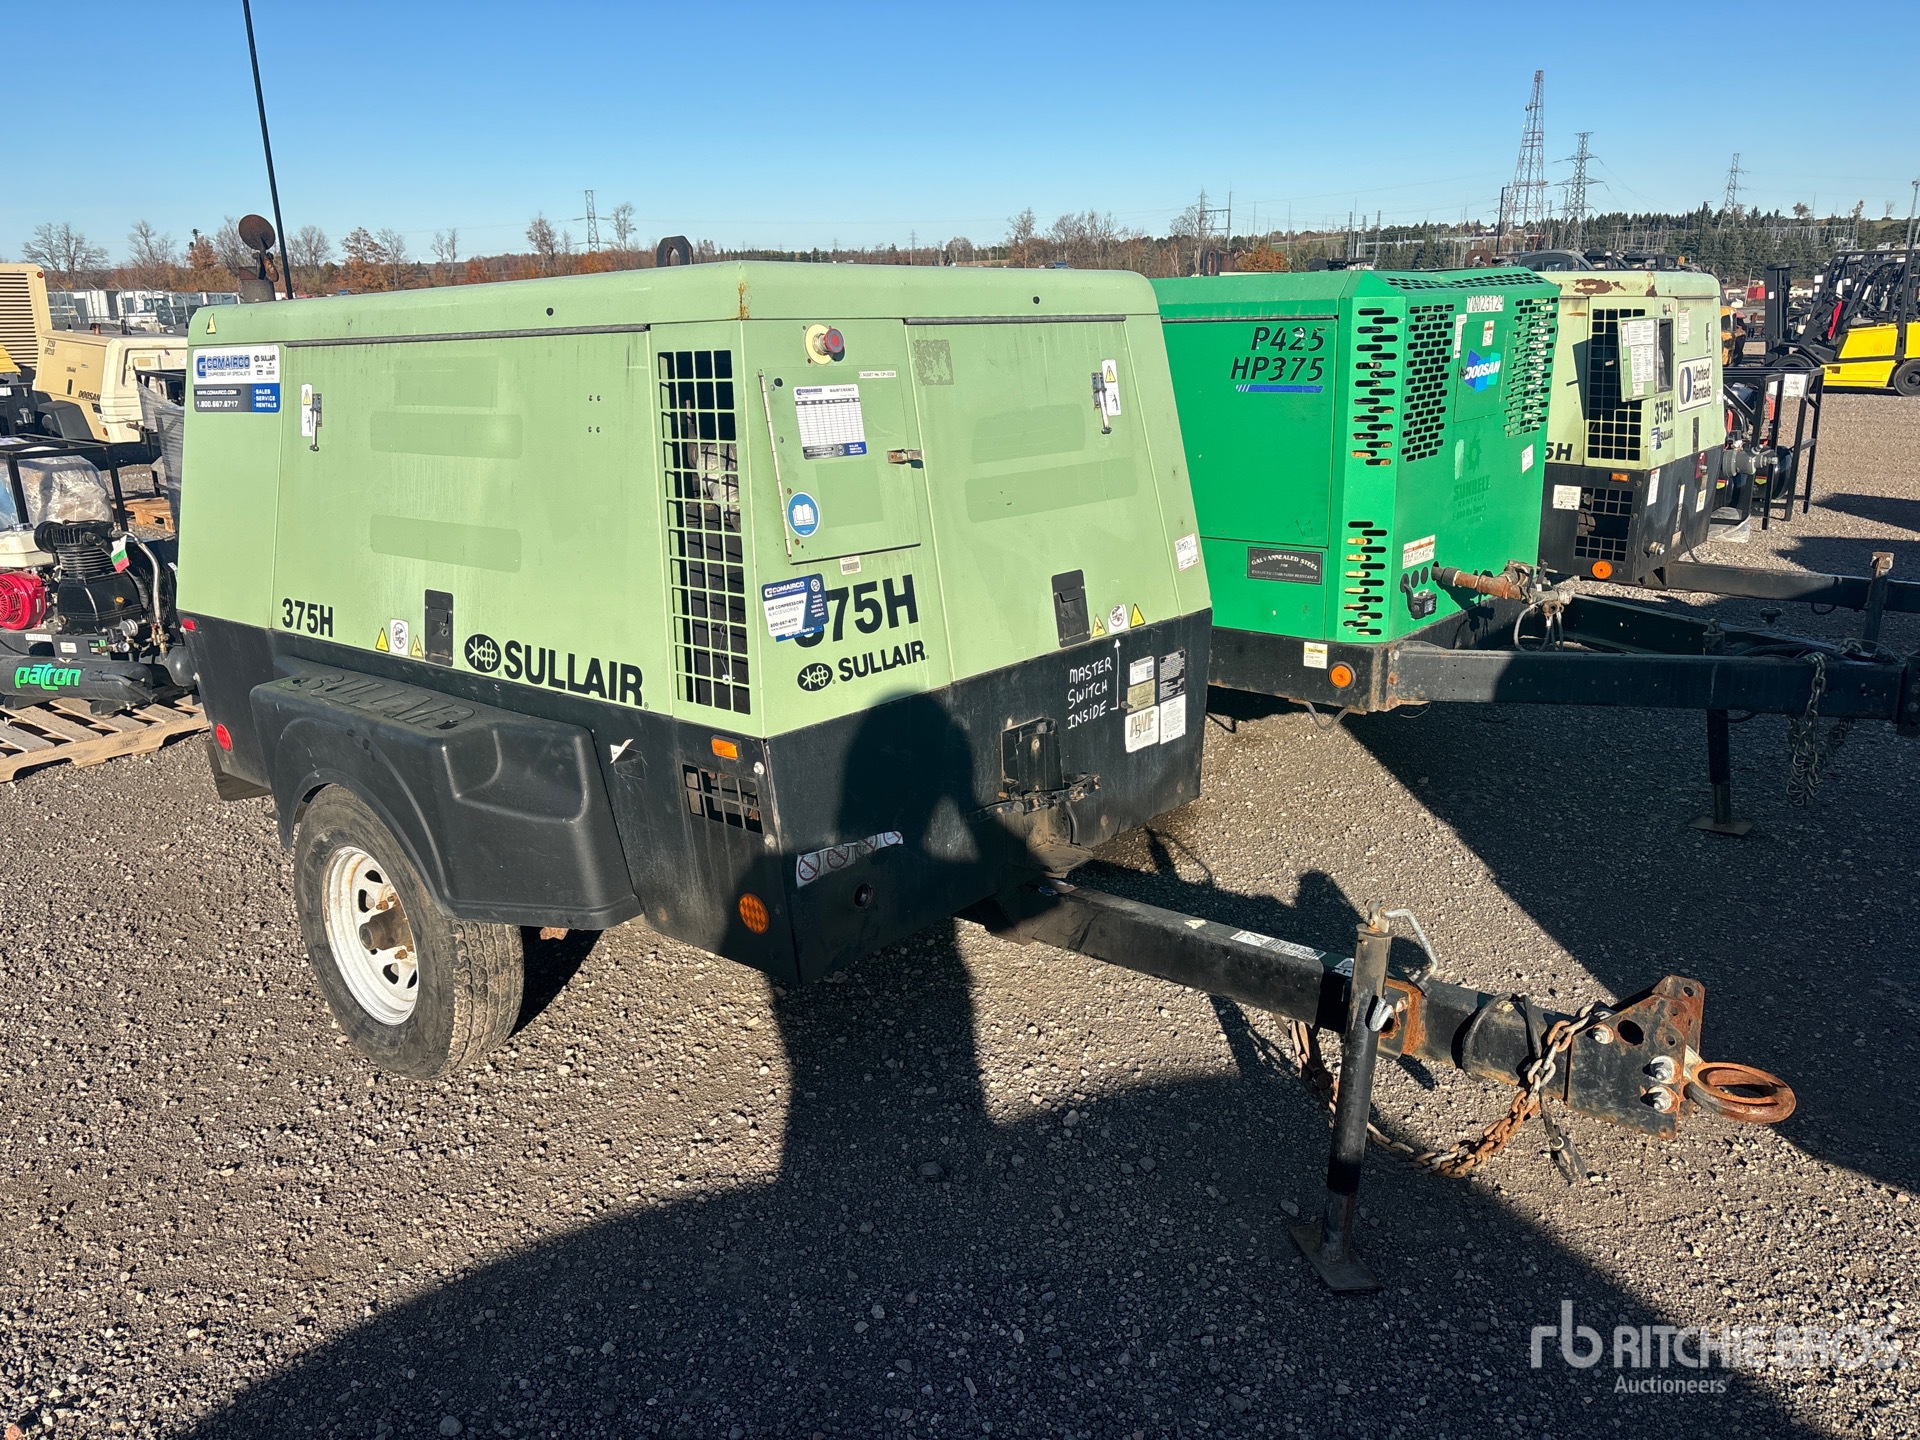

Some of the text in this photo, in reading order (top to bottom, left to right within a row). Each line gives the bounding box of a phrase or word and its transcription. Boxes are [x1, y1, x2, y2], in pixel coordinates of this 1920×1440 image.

[1251, 327, 1325, 351] P425
[207, 355, 250, 370] COMAIRCO
[1230, 357, 1325, 381] HP375
[1465, 360, 1501, 380] DOOSAN
[1693, 363, 1711, 382] United
[78, 390, 101, 401] DOOSAN
[1693, 383, 1711, 401] Rentals
[1655, 400, 1673, 425] 375H
[1251, 554, 1318, 571] GALVANNEALED STEEL
[772, 580, 805, 594] COMAIRCO
[281, 597, 334, 638] 375H
[503, 640, 644, 706] SULLAIR
[838, 640, 926, 682] SULLAIR
[1069, 656, 1113, 685] MASTER
[14, 663, 82, 691] patron
[1067, 679, 1108, 710] SWITCH
[1067, 699, 1107, 730] INSIDE
